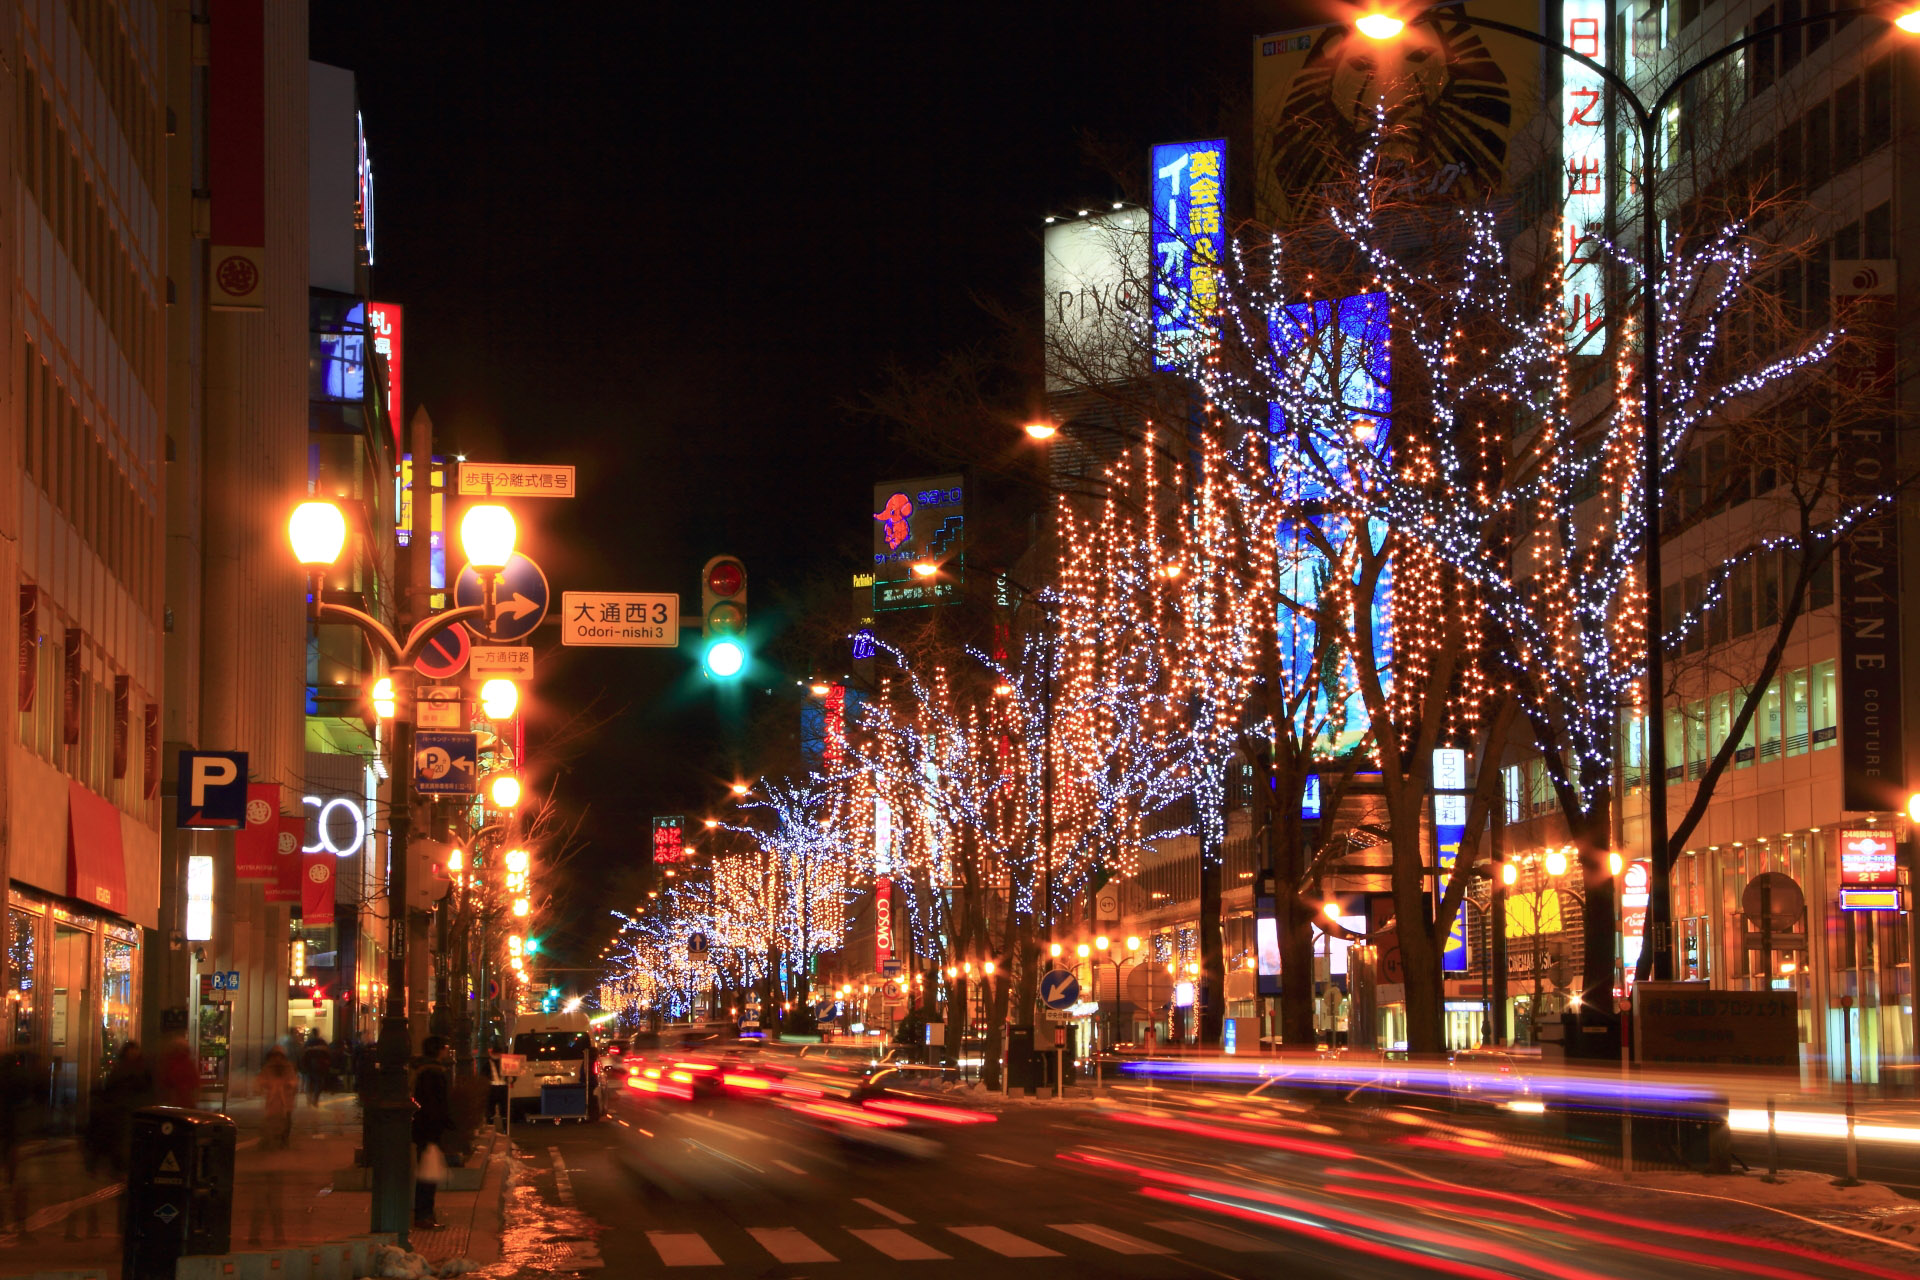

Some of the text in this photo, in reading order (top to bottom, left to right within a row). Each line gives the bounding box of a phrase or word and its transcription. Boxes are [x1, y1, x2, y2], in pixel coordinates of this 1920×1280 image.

[1568, 18, 1602, 333] 日之出ビル
[1158, 153, 1189, 326] イーオン
[466, 473, 568, 489] 歩車分離式信号
[573, 602, 668, 624] 大通西3
[577, 625, 664, 638] Odori-nishi 3
[474, 651, 529, 663] 一方通行路
[1864, 688, 1880, 777] COUTURE
[191, 756, 238, 807] P
[1858, 872, 1880, 882] 2F
[877, 898, 889, 949] COSMO
